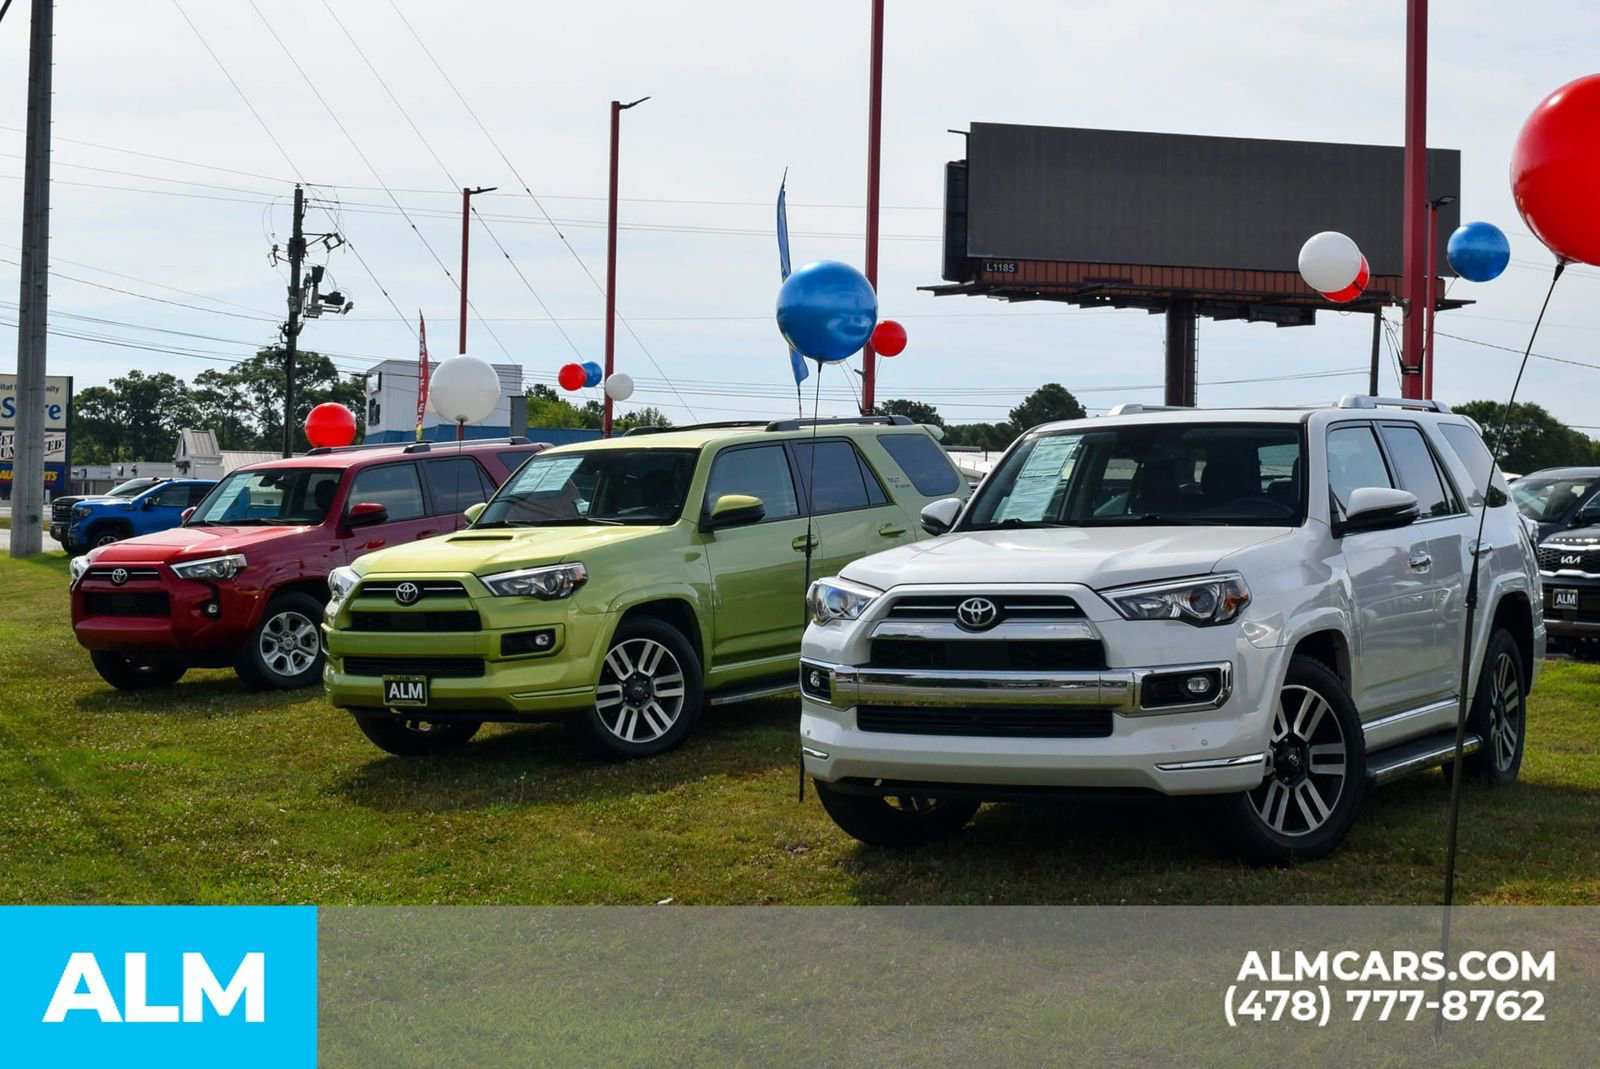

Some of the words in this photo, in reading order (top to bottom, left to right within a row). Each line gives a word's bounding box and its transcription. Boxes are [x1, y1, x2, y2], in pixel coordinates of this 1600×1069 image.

[986, 263, 1015, 273] L1185
[1556, 593, 1576, 605] ALM
[389, 682, 423, 699] ALM
